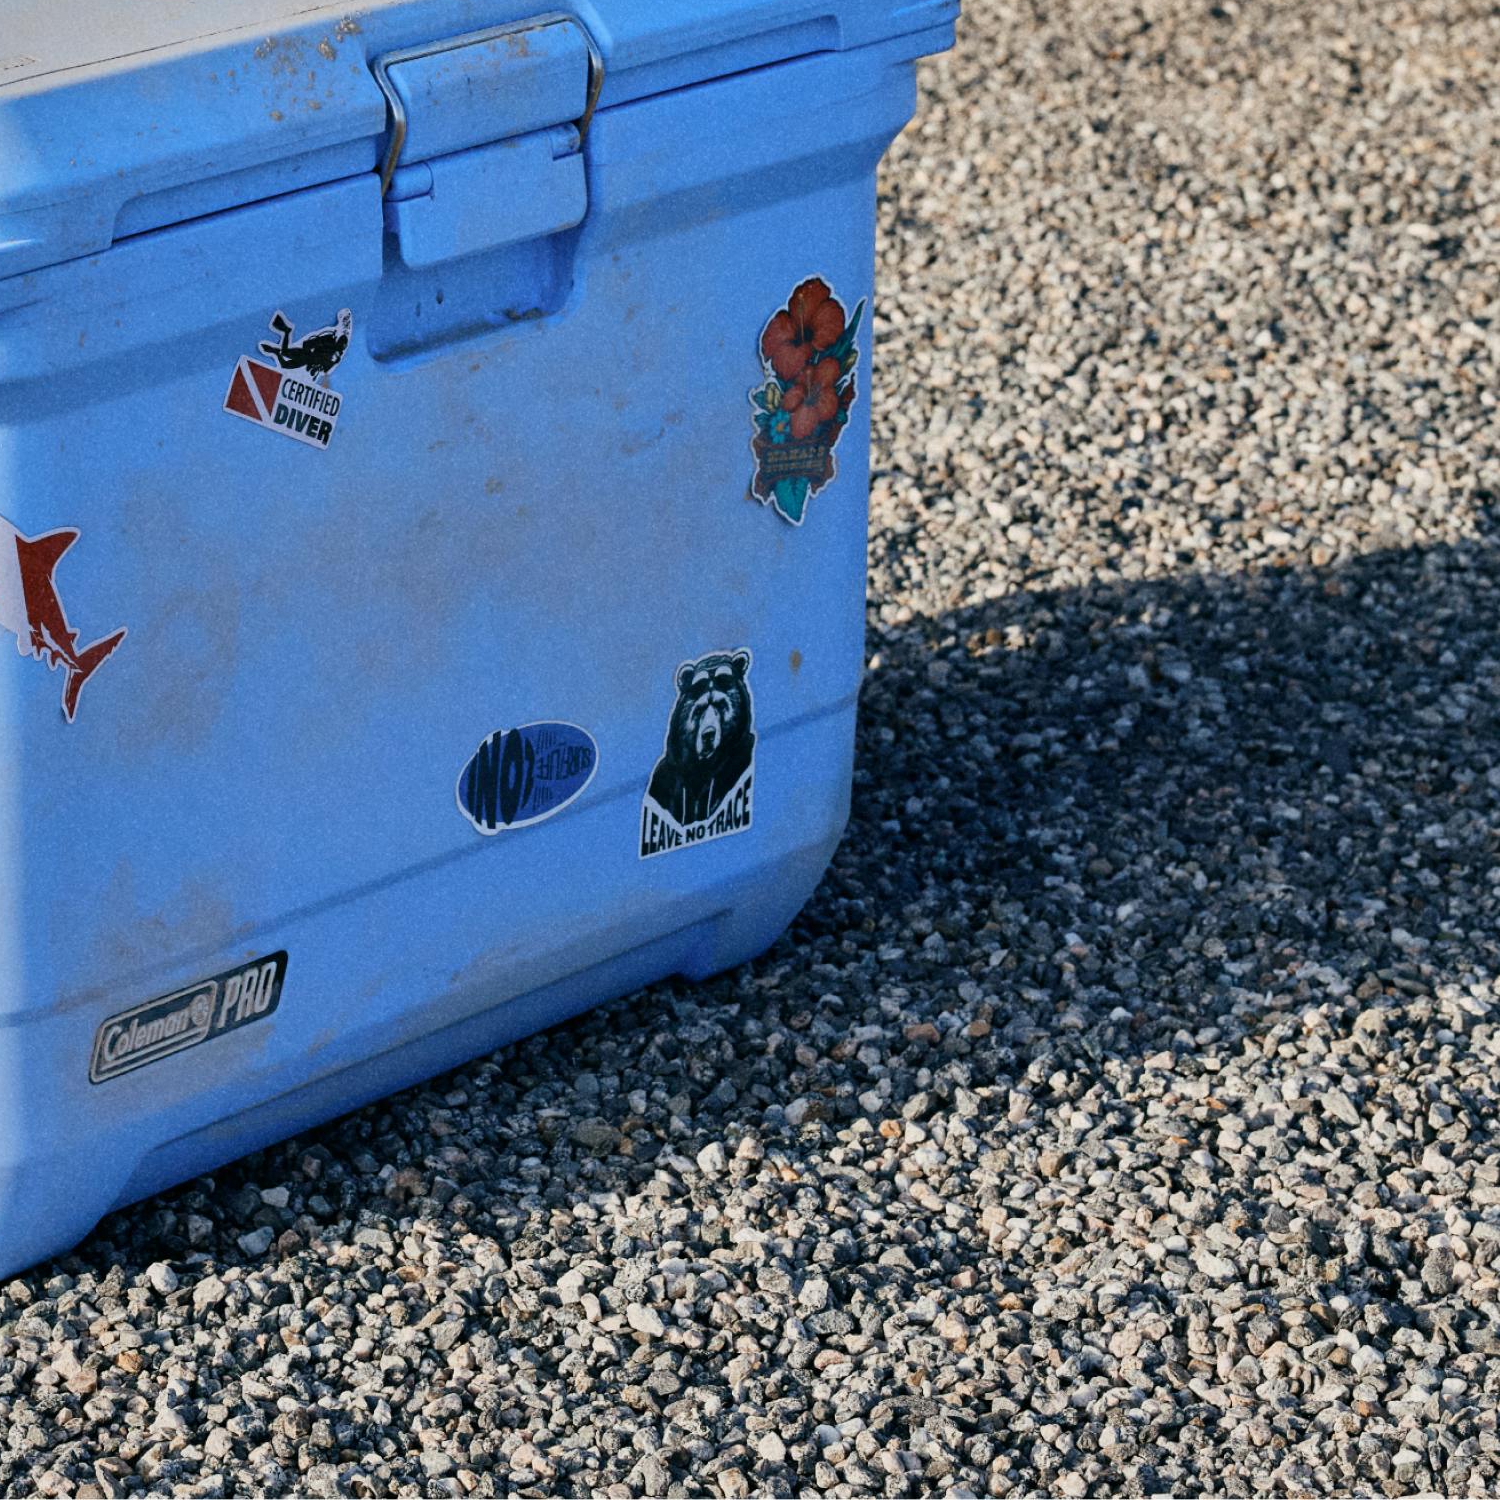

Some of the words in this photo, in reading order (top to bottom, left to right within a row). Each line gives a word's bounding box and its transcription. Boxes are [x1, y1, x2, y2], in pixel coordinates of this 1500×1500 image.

[274, 403, 332, 445] DIVER
[283, 378, 340, 416] CERTIFIED
[640, 805, 682, 856] LEAVE
[686, 822, 705, 843] NO
[706, 775, 753, 841] TRACE
[104, 1009, 190, 1061] Coleman
[218, 961, 277, 1028] PRO
